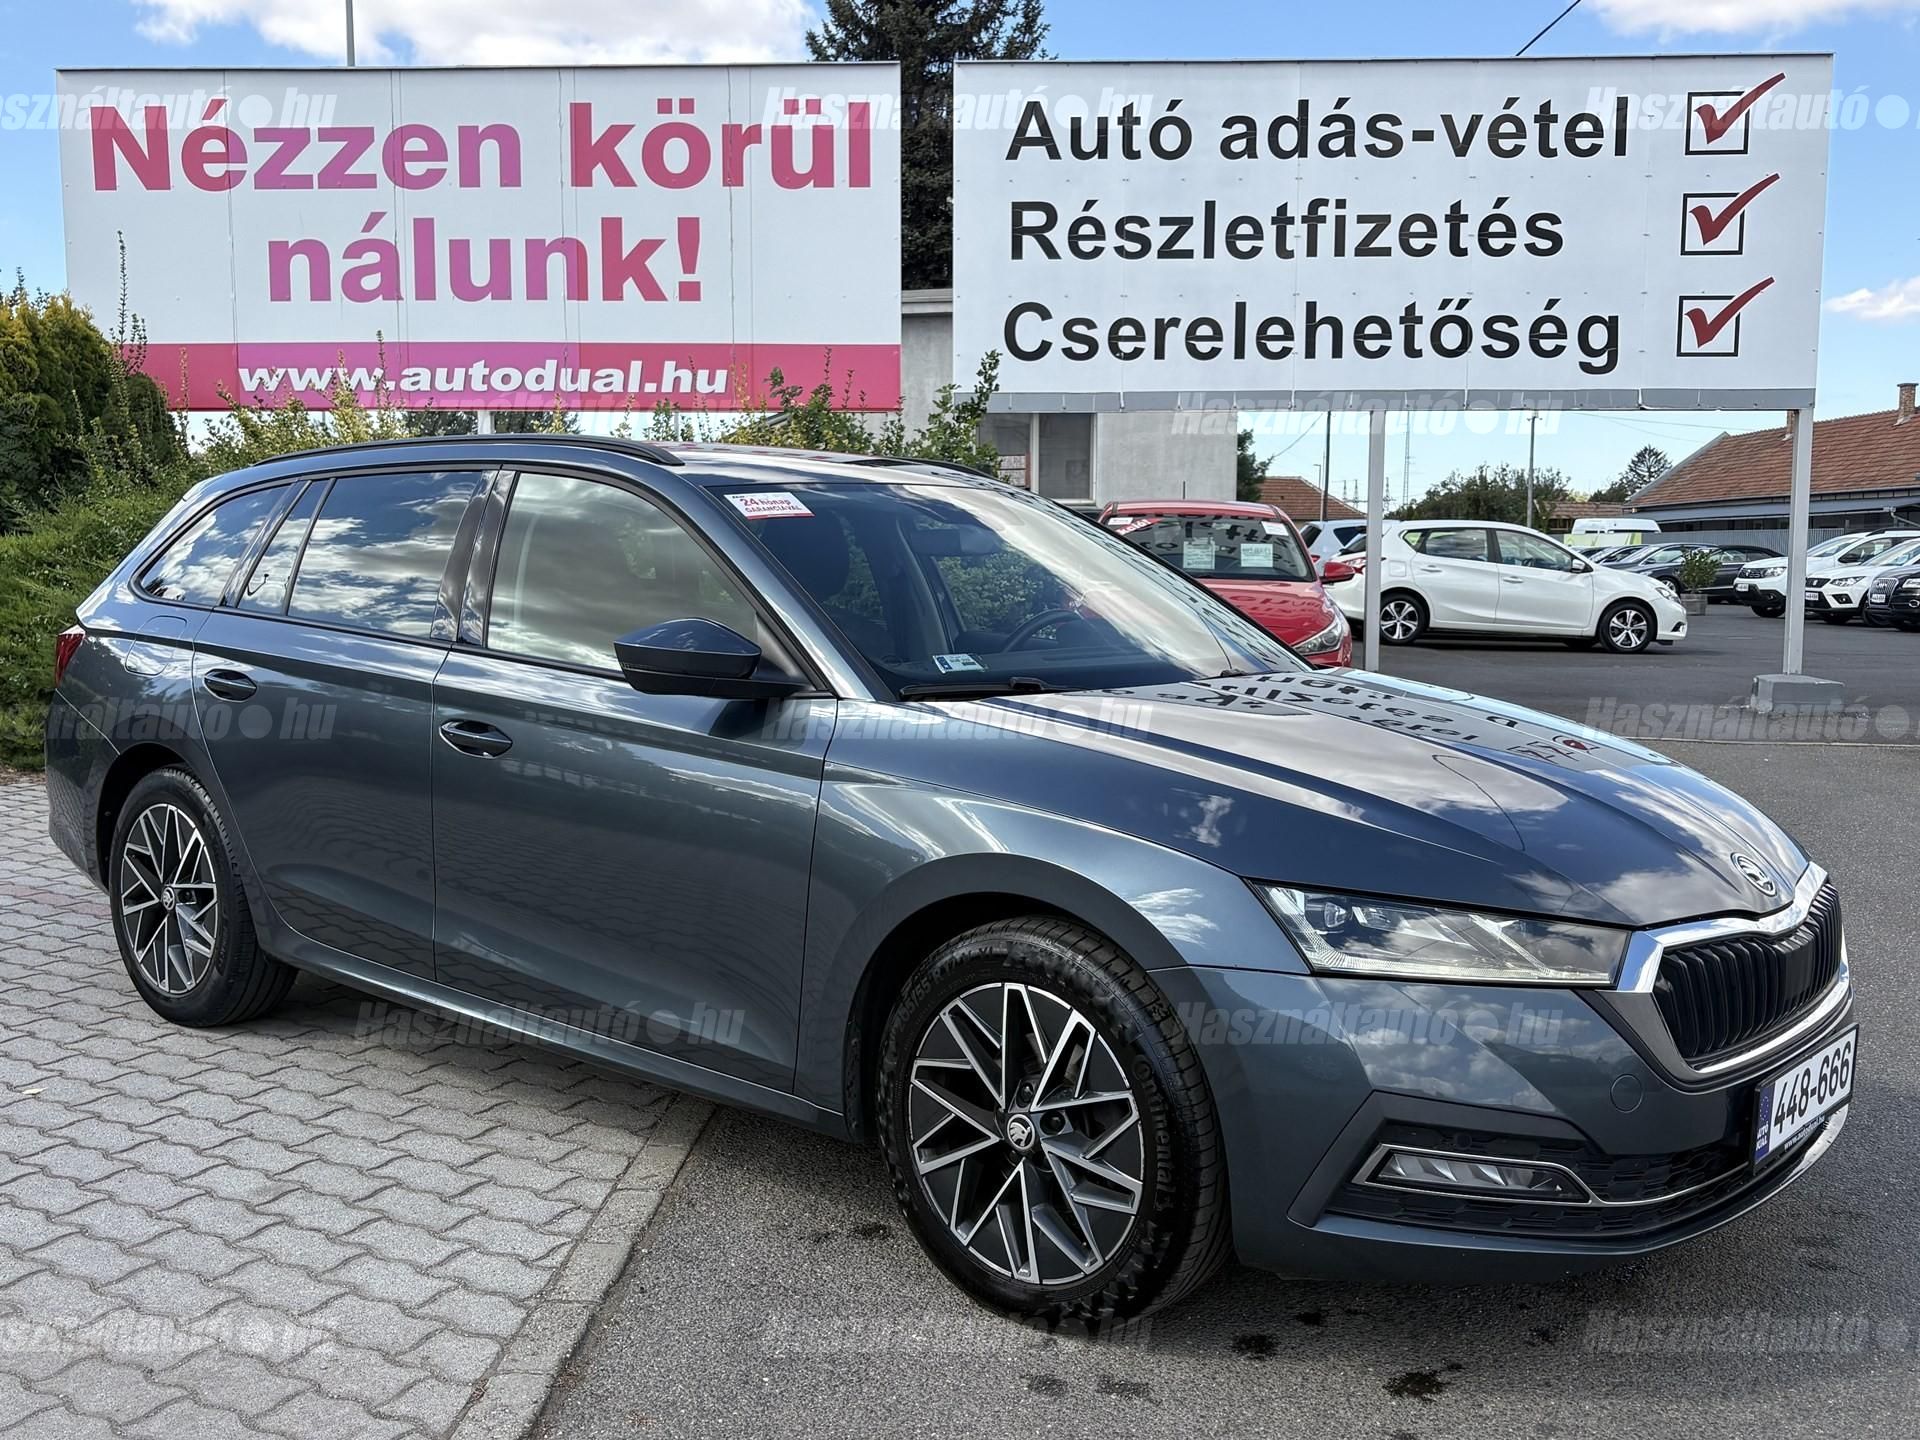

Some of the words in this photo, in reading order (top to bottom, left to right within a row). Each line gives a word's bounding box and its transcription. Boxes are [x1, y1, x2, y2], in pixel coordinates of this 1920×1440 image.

[89, 98, 522, 191] Nézzen
[569, 97, 872, 190] körül
[1005, 98, 1194, 161] Autó
[1219, 96, 1629, 161] adás-vétel
[267, 211, 701, 302] nálunk!
[1010, 196, 1564, 260] Részletfizetés
[1003, 297, 1620, 375] Cserelehetőség
[238, 359, 729, 393] www.autodual.hu
[739, 498, 759, 507] 24
[1774, 1040, 1852, 1134] 448-666
